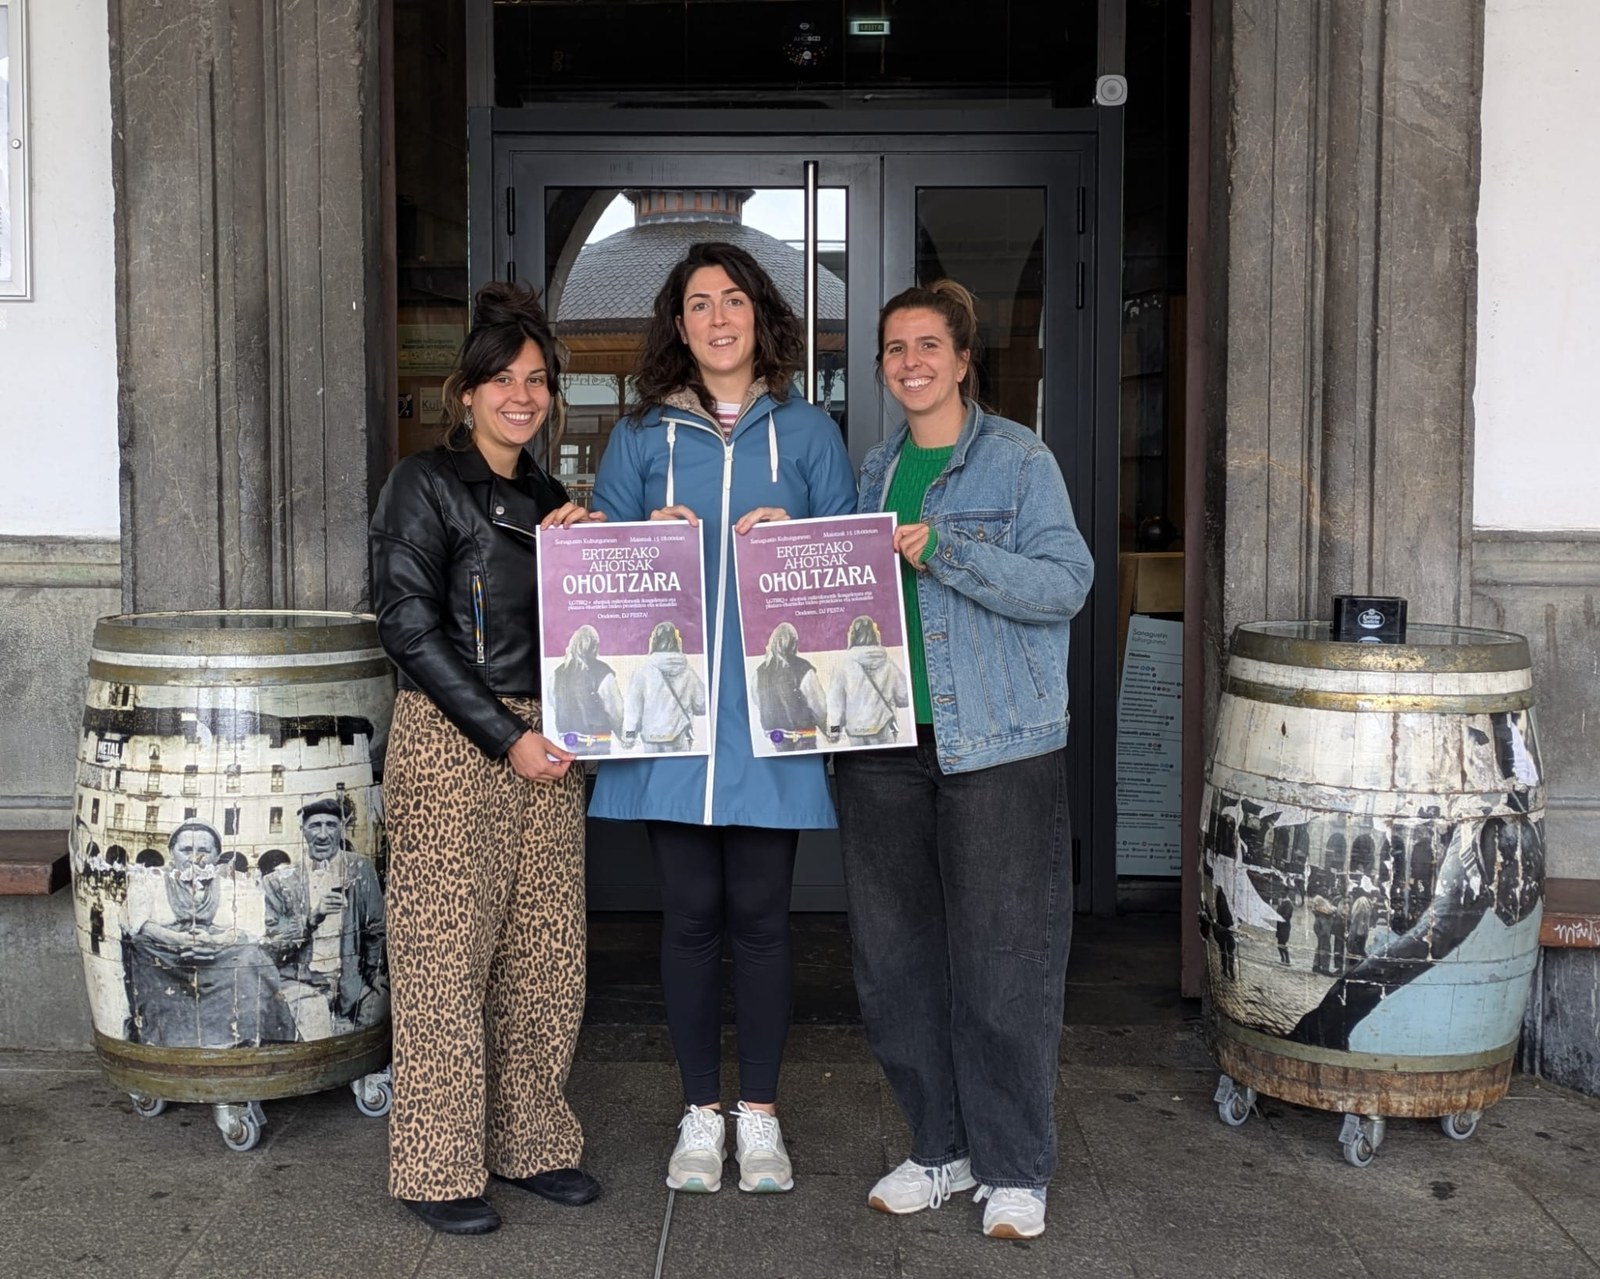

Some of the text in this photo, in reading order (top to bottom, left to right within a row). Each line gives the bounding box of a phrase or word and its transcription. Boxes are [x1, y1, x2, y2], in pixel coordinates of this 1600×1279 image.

[582, 546, 660, 560] ERTZETAKO
[776, 540, 853, 558] ERTZETAKO
[589, 559, 654, 572] AHOTSAK
[784, 554, 848, 570] AHOTSAK
[562, 571, 682, 595] OHOLTZARA
[758, 564, 877, 593] OHOLTZARA
[1133, 628, 1168, 639] Sanagustin
[97, 740, 120, 756] METAL
